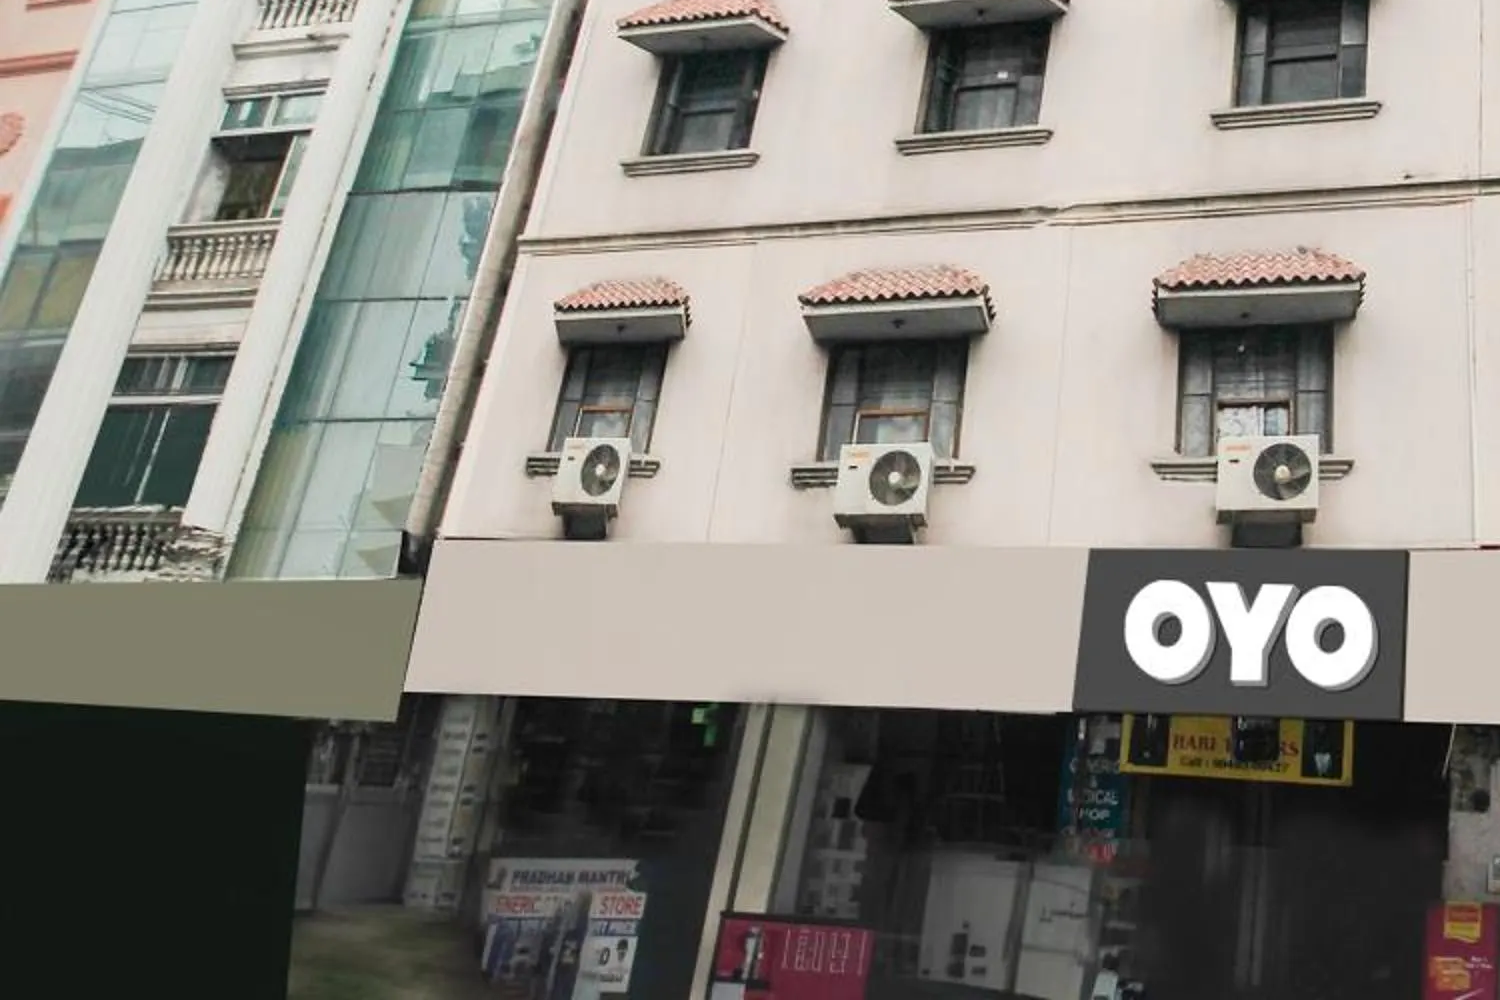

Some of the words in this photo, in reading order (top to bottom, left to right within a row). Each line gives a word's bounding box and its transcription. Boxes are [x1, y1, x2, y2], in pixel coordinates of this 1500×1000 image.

[1123, 578, 1379, 692] OYO
[511, 870, 576, 885] PRADHAN
[599, 895, 644, 915] STORE
